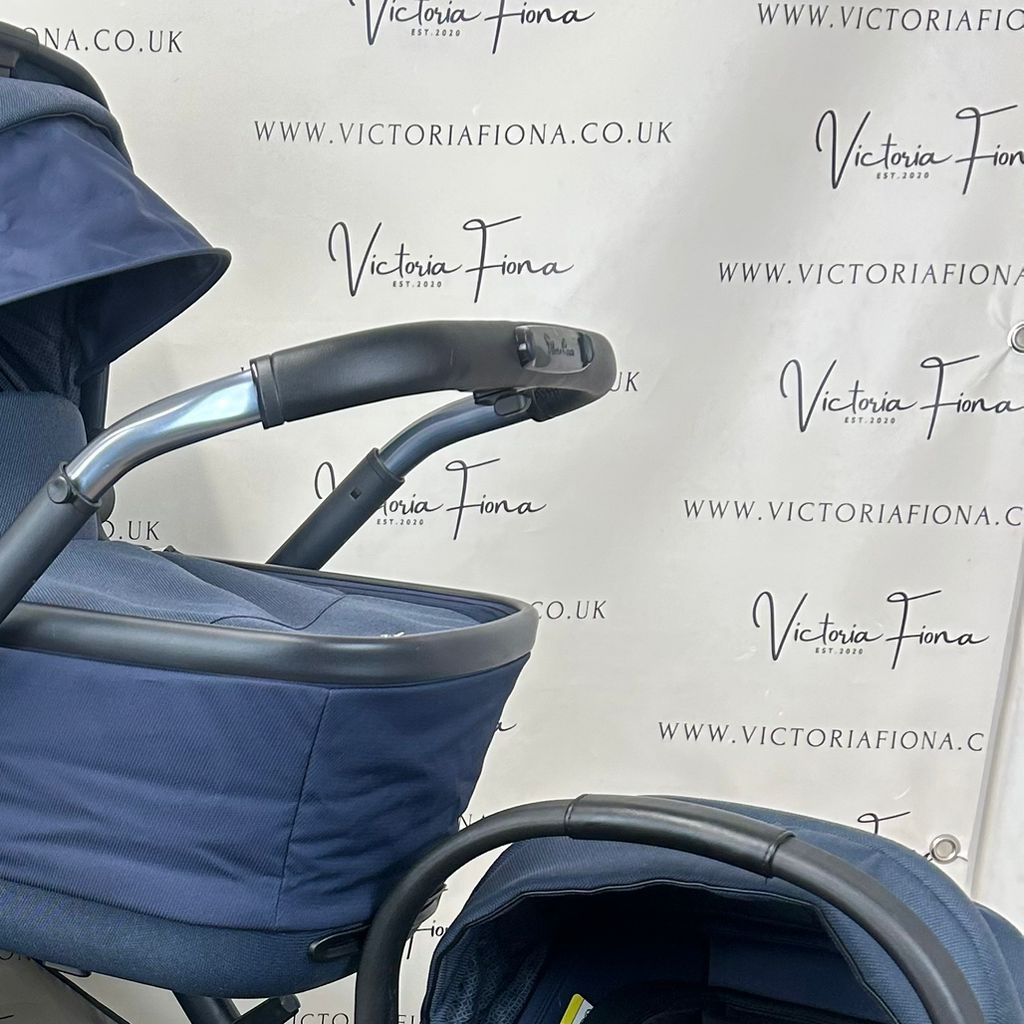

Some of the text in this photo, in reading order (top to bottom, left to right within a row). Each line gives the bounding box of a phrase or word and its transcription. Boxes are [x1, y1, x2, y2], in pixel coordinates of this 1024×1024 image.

[410, 28, 461, 37] EST.2020
[254, 120, 674, 146] WWW.VICTORIAFIONA.CO.UK
[815, 104, 1024, 196] Victoria Fion
[876, 171, 930, 180] EST.2020
[328, 215, 576, 304] Victoria Fiona
[392, 280, 443, 288] EST.2020
[779, 354, 1024, 441] Victoria Fiona
[844, 416, 897, 425] EST.2020
[446, 458, 547, 541] Fiona
[376, 518, 425, 526] EST.2020
[752, 589, 990, 670] Victoria Fiona
[814, 646, 865, 655] EST.2020
[658, 721, 986, 751] WWW.VICTORIAFIONA.C
